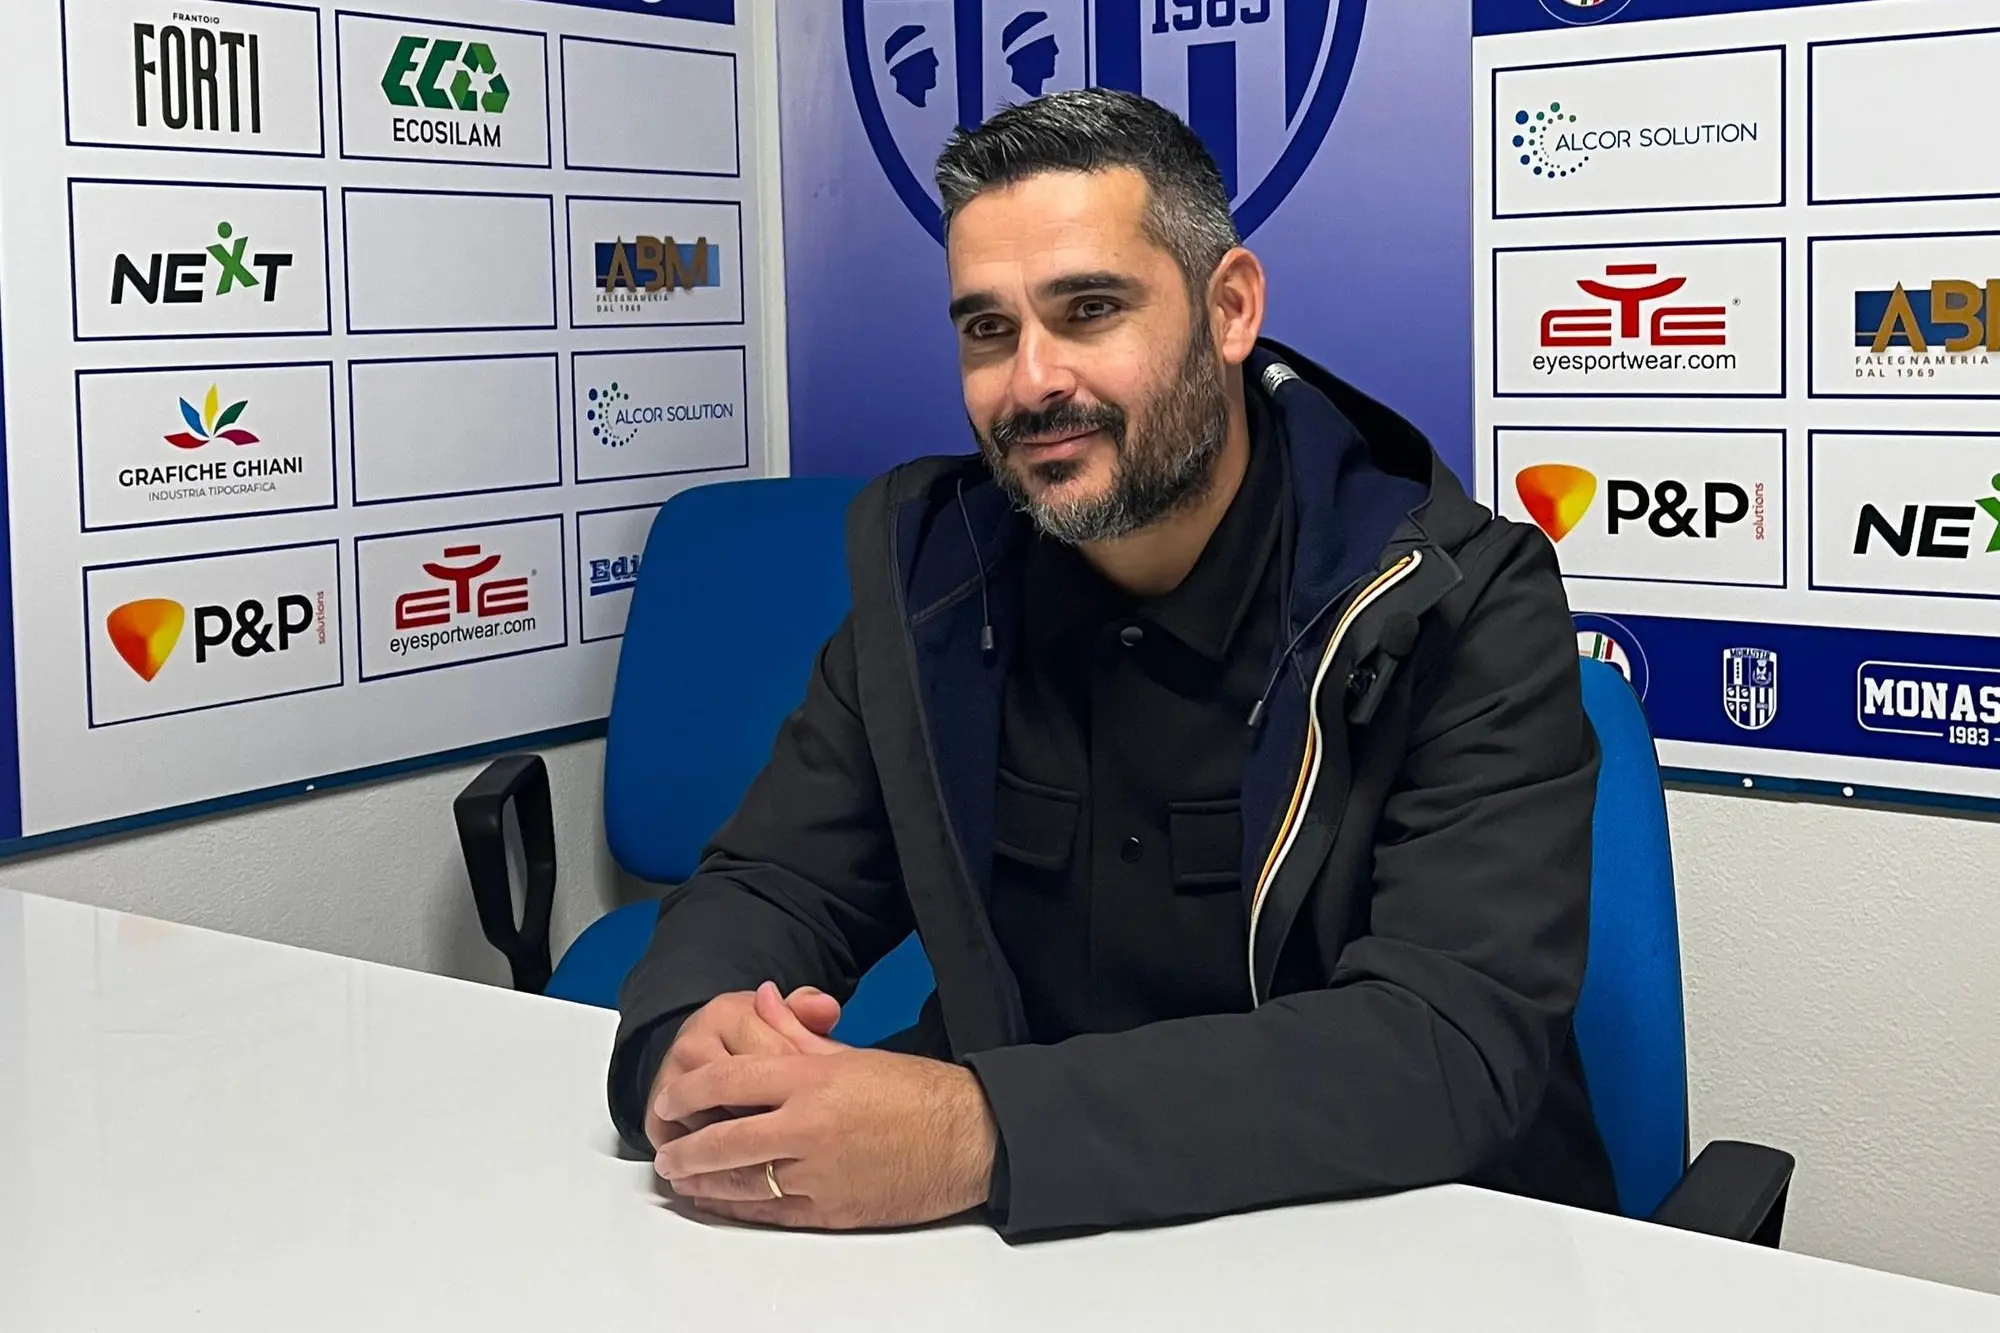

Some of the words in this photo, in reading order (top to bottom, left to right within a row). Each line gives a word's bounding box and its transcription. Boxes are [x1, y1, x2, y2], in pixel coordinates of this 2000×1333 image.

[173, 12, 220, 24] FRANTOIO
[134, 23, 261, 133] FORTI
[393, 118, 501, 148] ECOSILAM
[1555, 130, 1631, 152] ALCOR
[1640, 122, 1757, 148] SOLUTION
[111, 222, 293, 304] NEXT
[605, 235, 707, 292] ABM
[597, 304, 614, 312] DAL
[1541, 263, 1726, 347] EYE
[1870, 278, 2000, 353] AB
[1532, 351, 1736, 374] eyesportwear.com
[1855, 355, 1989, 365] FALEGNAMERIA
[1855, 368, 1885, 378] DAL
[1898, 368, 1935, 378] 1969
[615, 406, 662, 425] ALCOR
[666, 403, 733, 422] SOLUTION
[118, 462, 227, 487] GRAFICHE
[232, 456, 303, 477] GHIANI
[149, 488, 206, 502] INDUSTRIA
[208, 482, 277, 497] TIPOGRAFICA
[1607, 479, 1749, 539] P&P
[1753, 482, 1764, 540] solutions
[589, 554, 639, 584] Edi
[395, 544, 529, 630] EYE
[194, 594, 314, 664] P&P
[316, 591, 326, 645] solutions
[390, 617, 536, 656] eyesportwear.com
[1864, 677, 2000, 724] MONAS
[1949, 725, 1989, 746] 1983
